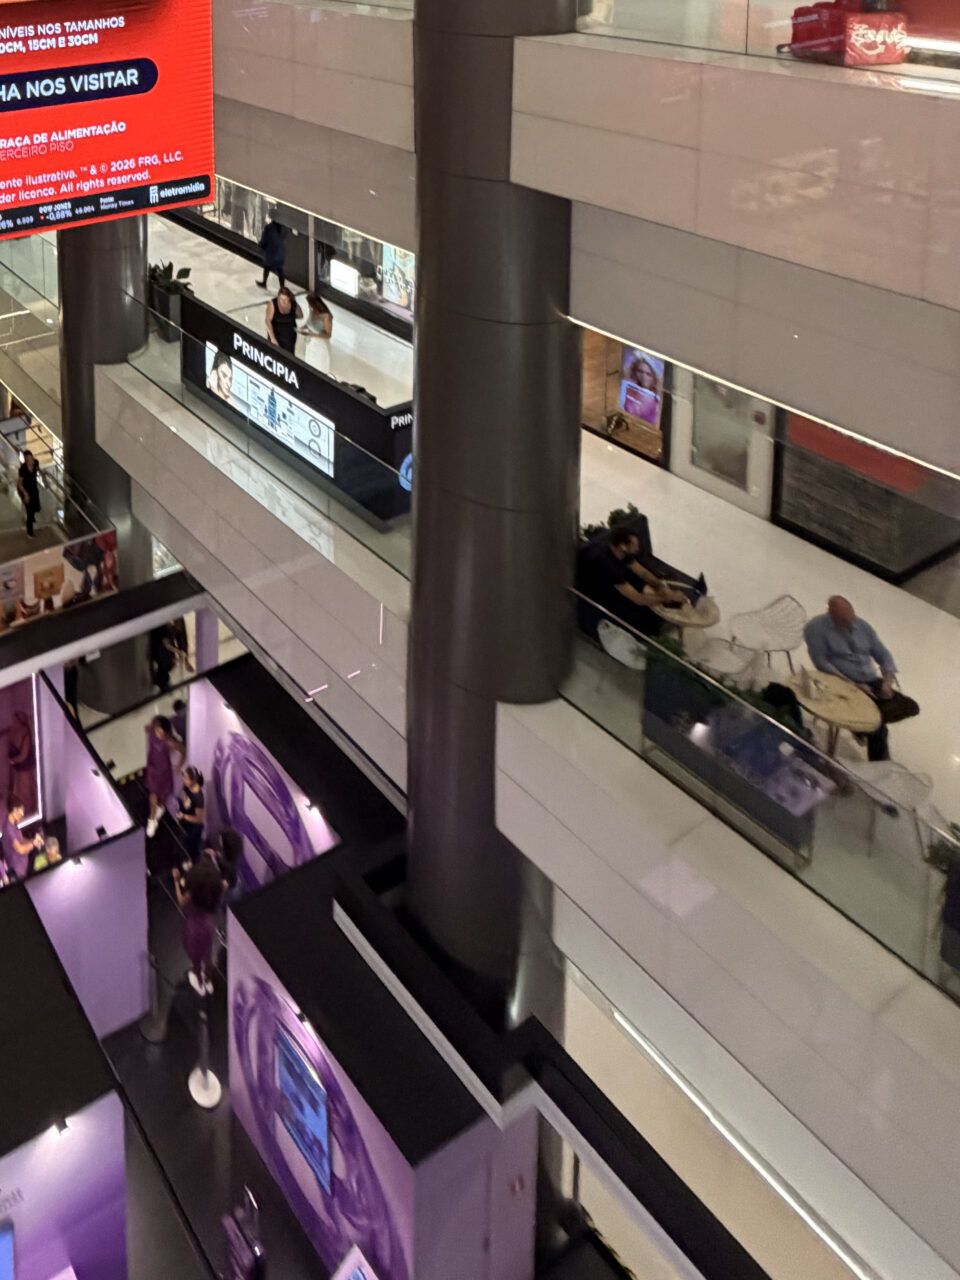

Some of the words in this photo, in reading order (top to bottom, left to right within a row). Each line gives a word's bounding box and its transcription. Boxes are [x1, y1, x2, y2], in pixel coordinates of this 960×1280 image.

[38, 23, 61, 35] NOS
[64, 16, 125, 33] TAMANHOS
[28, 37, 56, 51] 15CM
[58, 36, 66, 48] E
[67, 33, 99, 47] 30CM
[26, 78, 66, 98] NOS
[70, 68, 139, 93] VISITAR
[33, 133, 48, 144] DE
[50, 121, 127, 142] ALIMENTAÇÃO
[49, 140, 75, 153] PISO
[25, 170, 78, 186] ilustrativa.
[110, 158, 136, 172] 2026
[138, 154, 161, 167] FRG,
[164, 151, 184, 164] LLC.
[60, 181, 74, 194] All
[76, 177, 105, 192] rights
[233, 332, 300, 389] PRINCIPIA
